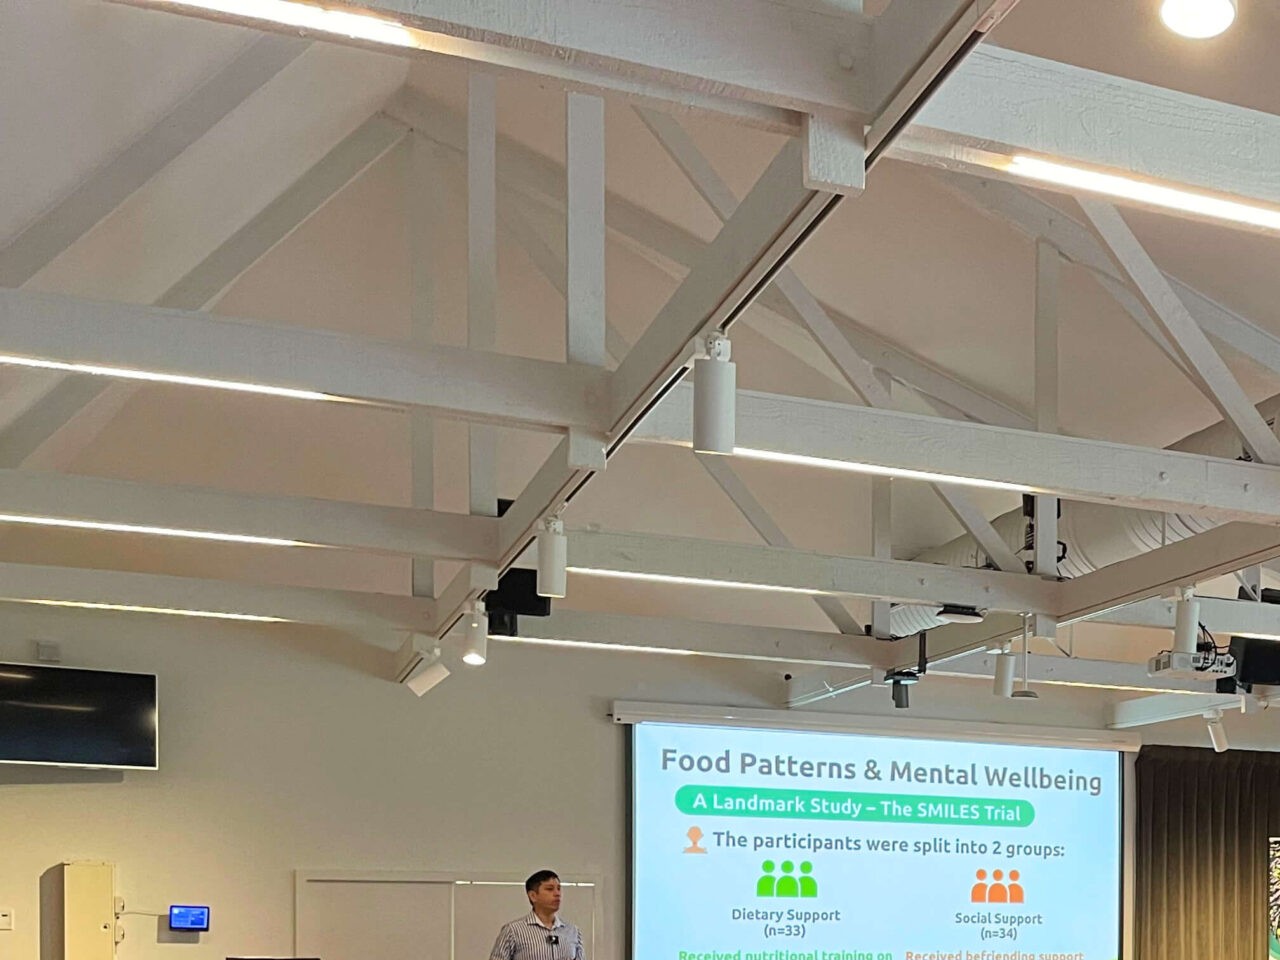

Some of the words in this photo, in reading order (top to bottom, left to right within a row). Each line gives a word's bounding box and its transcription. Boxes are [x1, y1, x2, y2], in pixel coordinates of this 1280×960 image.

[662, 749, 730, 773] Food
[741, 753, 856, 779] Patterns
[864, 759, 882, 781] &
[891, 761, 977, 785] Mental
[985, 766, 1101, 796] Wellbeing
[692, 793, 707, 808] A
[713, 794, 805, 812] Landmark
[811, 798, 862, 818] Study
[880, 801, 912, 817] The
[917, 803, 979, 819] SMILES
[984, 805, 1021, 821] Trial
[713, 831, 747, 847] The
[753, 833, 861, 853] participants
[866, 838, 908, 852] were
[914, 838, 951, 855] split
[955, 839, 987, 855] into
[992, 841, 1002, 855] 2
[1006, 845, 1065, 859] groups:
[732, 908, 783, 923] Dietary
[786, 909, 841, 923] Support
[955, 912, 991, 924] Social
[994, 913, 1043, 926] Support
[764, 924, 806, 938] (n=33)
[980, 927, 1018, 940] (n=34)
